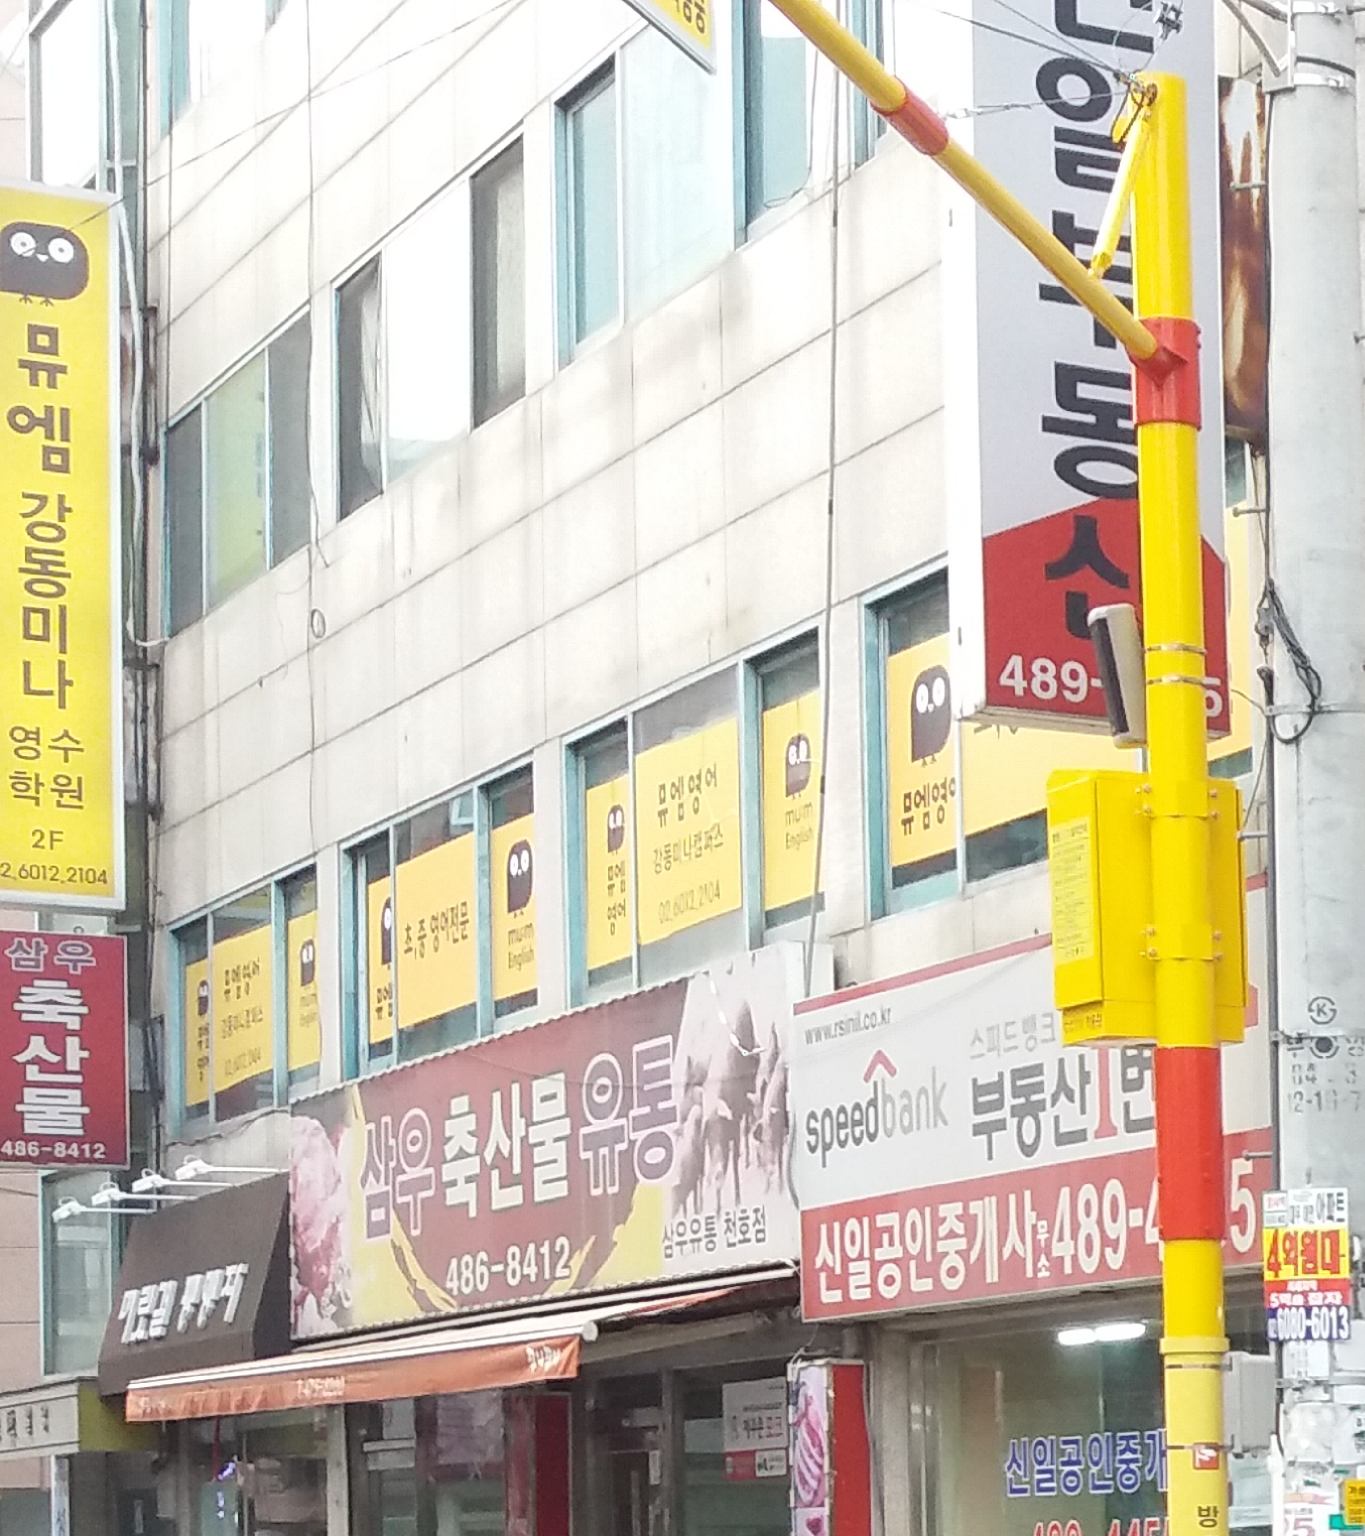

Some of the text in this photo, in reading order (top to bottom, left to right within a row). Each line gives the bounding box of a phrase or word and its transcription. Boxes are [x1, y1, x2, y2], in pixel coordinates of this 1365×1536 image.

[6, 323, 74, 710] 뮤엠 강동미나
[8, 726, 85, 764] 영수
[9, 769, 85, 809] 학원
[658, 764, 718, 828] 뮤엠영어
[31, 829, 65, 851] 2F
[6, 938, 96, 974] 삼우
[804, 1005, 892, 1045] www.rsinil.co.kr
[969, 1012, 1057, 1060] 스피드뱅크
[12, 979, 90, 1136] 축산물
[805, 1068, 948, 1168] speedbank
[971, 1046, 1156, 1162] 부동산1번
[1, 1140, 106, 1159] 486-8412
[360, 1035, 679, 1241] 삼우 축산물 유통
[662, 1205, 767, 1259] 삼우유통 천호점
[815, 1191, 1037, 1305] 신일공인중개사
[446, 1236, 571, 1297] 486-8412
[1004, 1428, 1168, 1498] 신일공인중개
